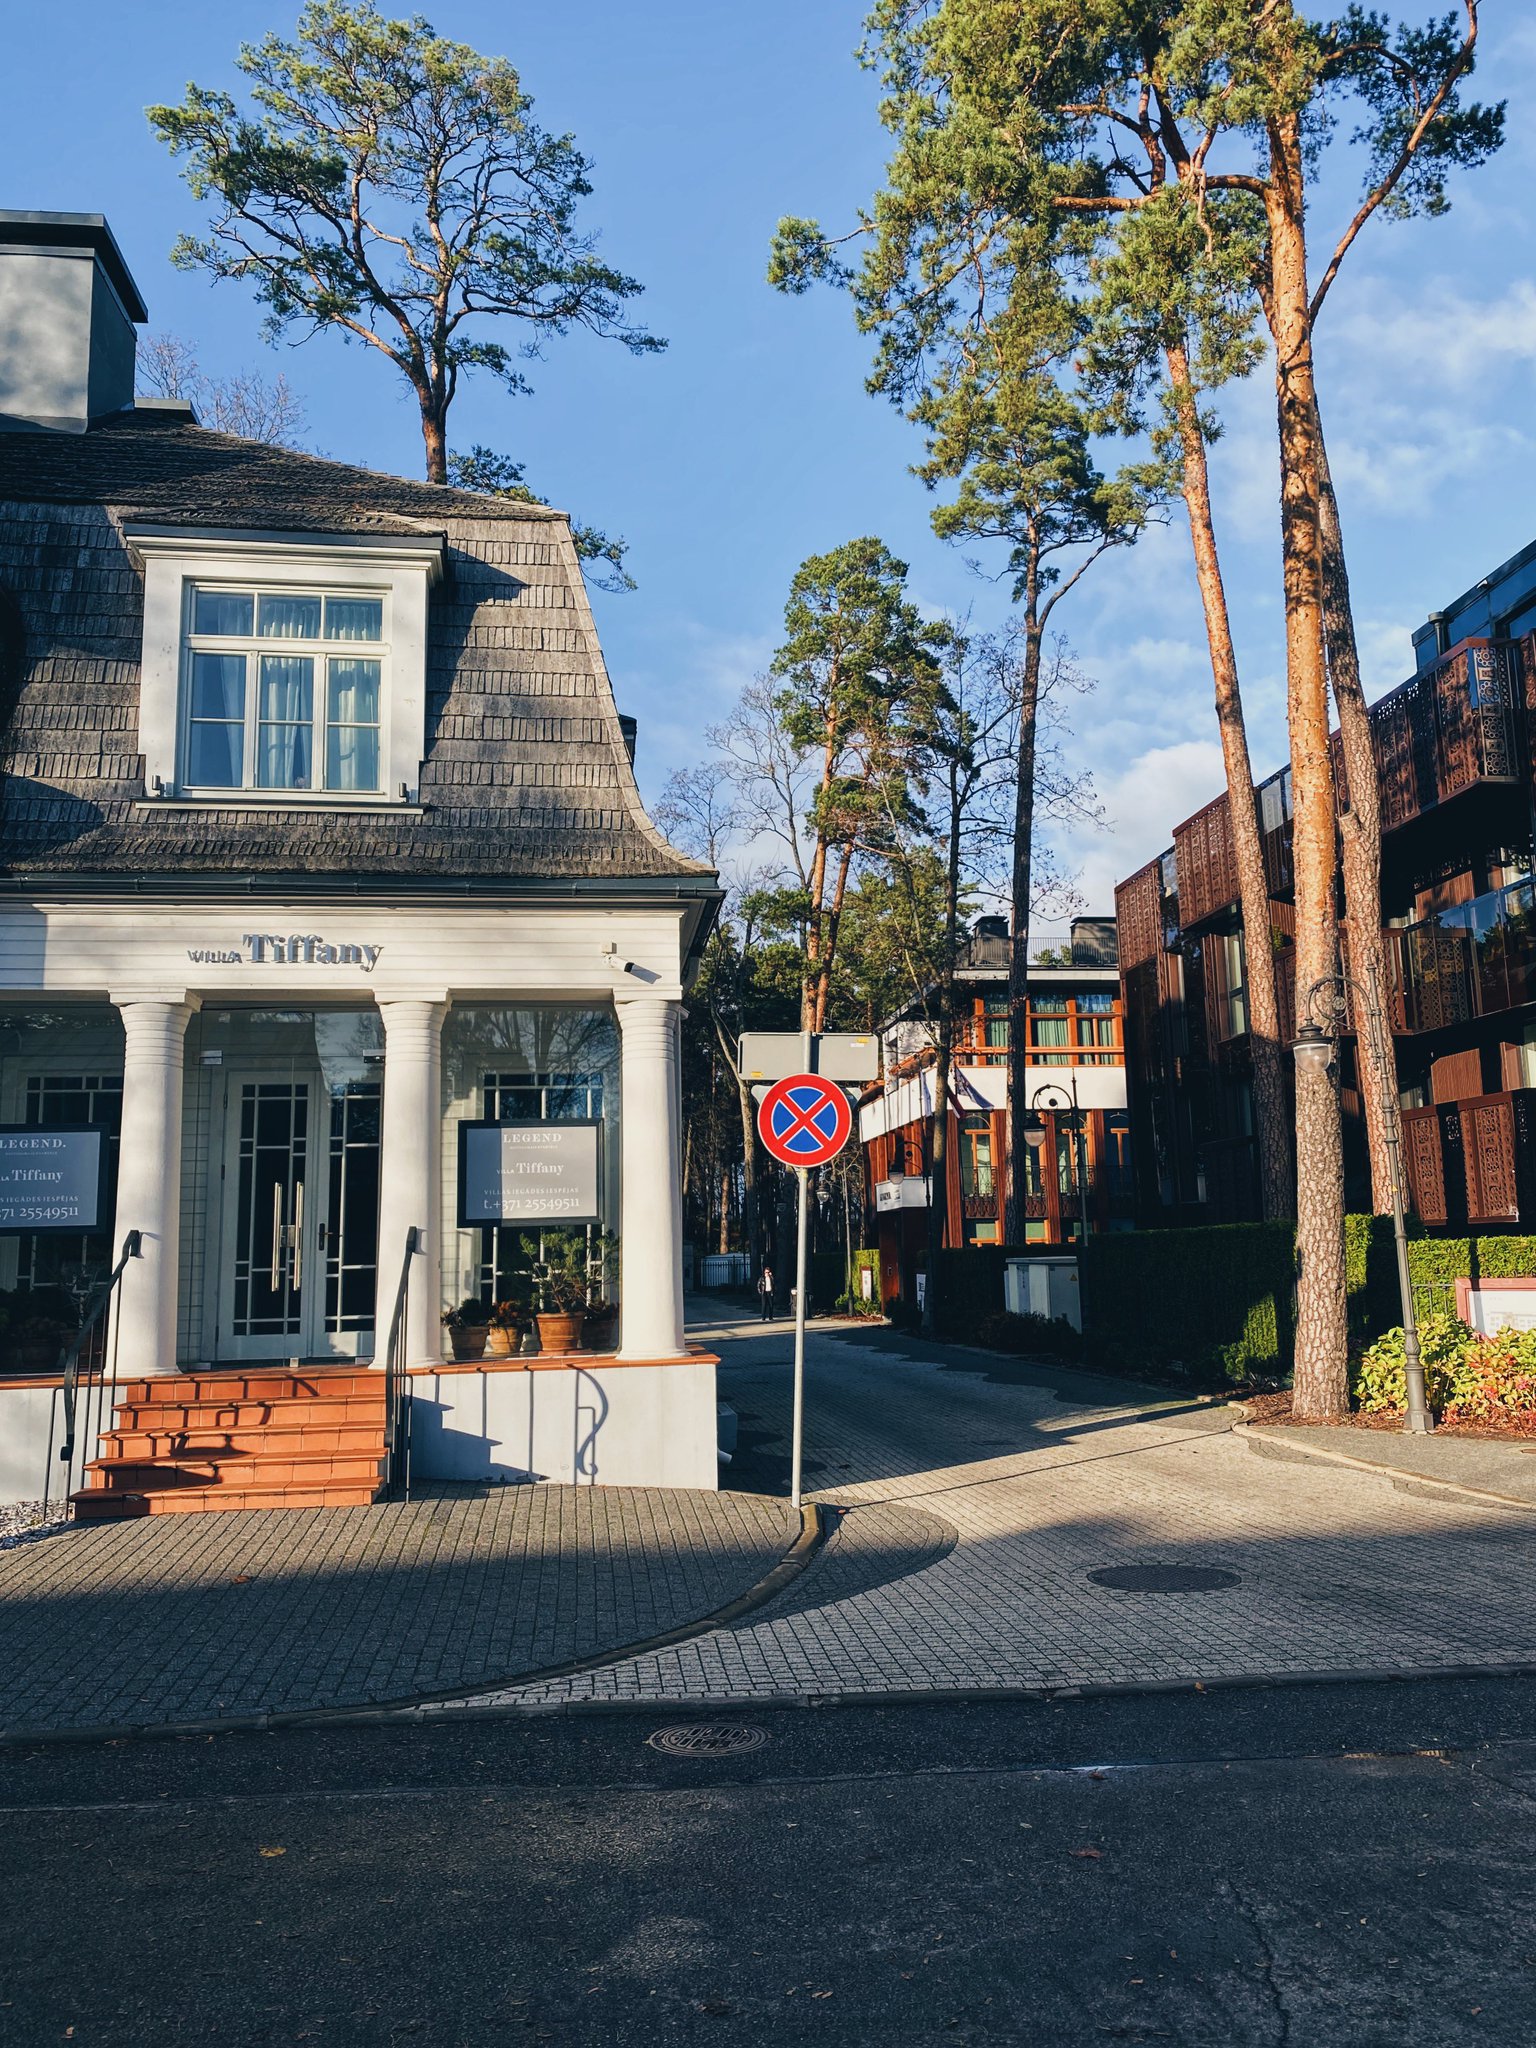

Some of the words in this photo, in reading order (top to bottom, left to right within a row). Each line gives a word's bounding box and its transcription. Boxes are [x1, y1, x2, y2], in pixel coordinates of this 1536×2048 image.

[187, 950, 241, 963] VILLA
[243, 934, 384, 972] Tiffany
[0, 1138, 66, 1149] LEGEND.
[516, 1162, 564, 1175] Tiffany
[11, 1169, 64, 1183] Tiffany
[484, 1188, 510, 1196] VILLAS
[525, 1198, 580, 1212] 25549511
[0, 1208, 15, 1220] 71
[19, 1206, 79, 1220] 25549511
